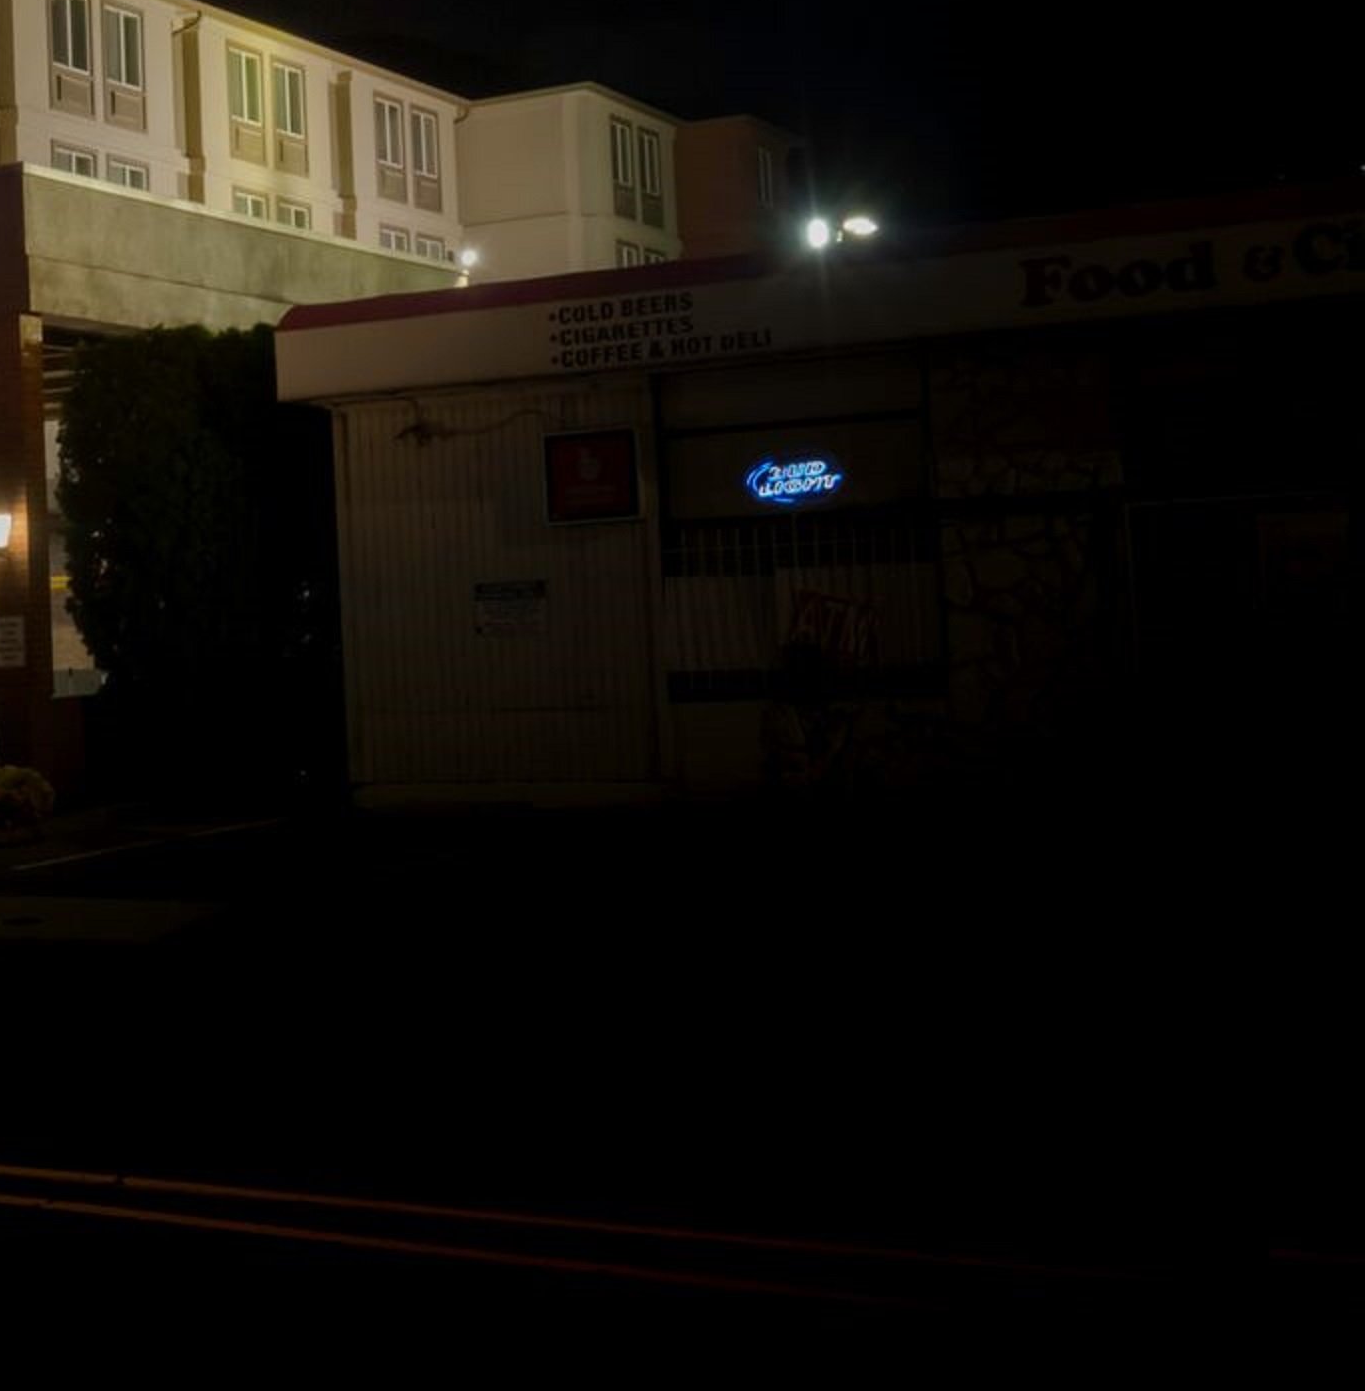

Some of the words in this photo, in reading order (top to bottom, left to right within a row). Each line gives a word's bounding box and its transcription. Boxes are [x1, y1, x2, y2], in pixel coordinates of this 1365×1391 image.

[1019, 241, 1217, 306] Food
[558, 302, 615, 325] COLD
[621, 292, 694, 317] BEERS
[559, 316, 694, 346] CIGARETTES
[561, 342, 643, 367] COFFEE
[671, 335, 713, 355] HOT
[720, 327, 772, 351] DELI
